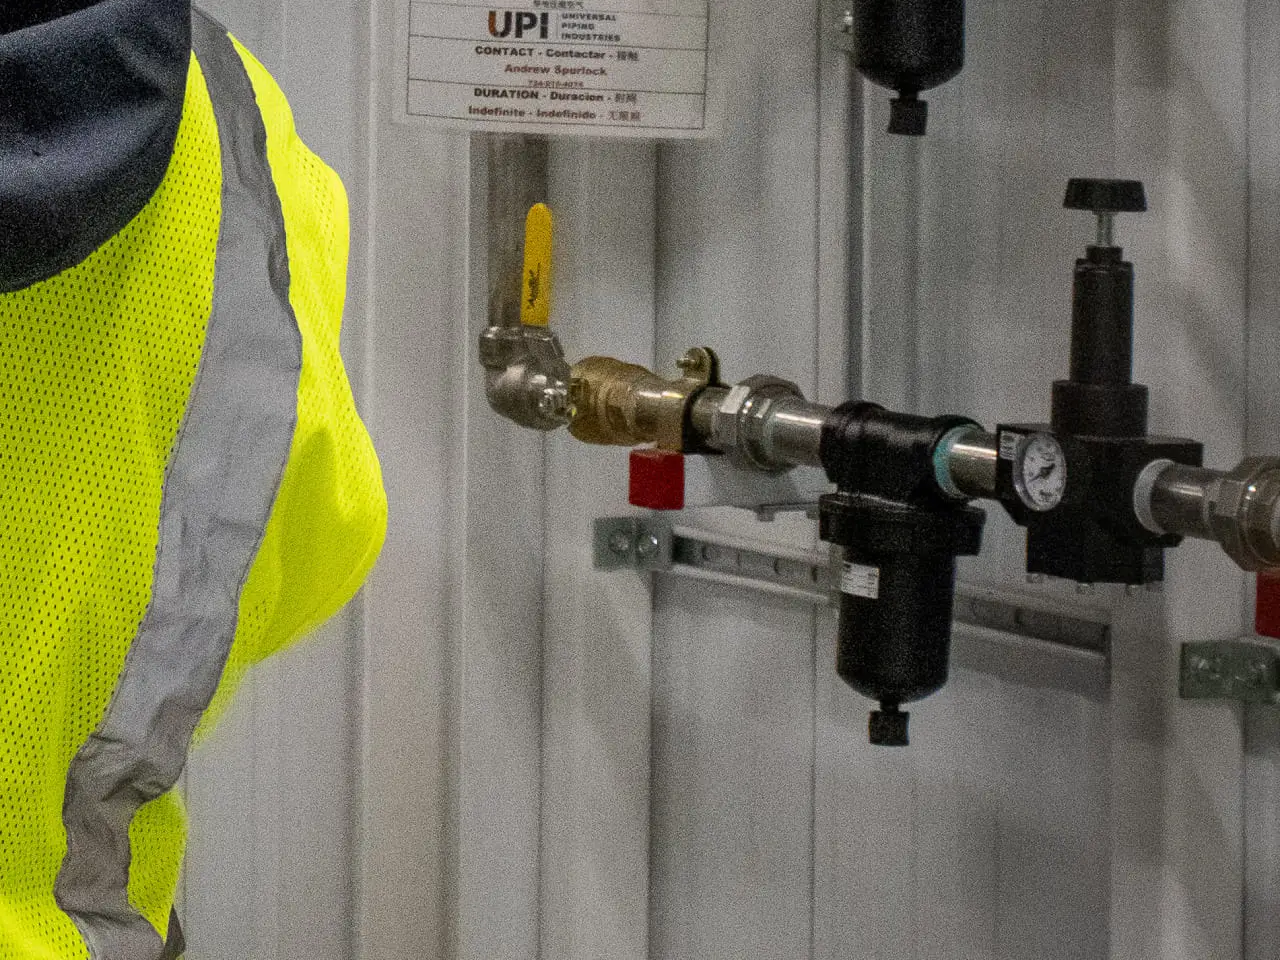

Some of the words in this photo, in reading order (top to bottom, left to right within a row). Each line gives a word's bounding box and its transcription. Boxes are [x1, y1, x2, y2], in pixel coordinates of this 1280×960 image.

[488, 10, 549, 39] UPI
[562, 12, 616, 21] UNIVERSAL
[561, 22, 595, 30] PIPING
[561, 33, 621, 41] INDUSTRIES
[475, 46, 534, 58] CONTACT
[504, 64, 551, 74] Andrew
[554, 65, 608, 76] Spurlock
[474, 88, 539, 100] DURATION
[550, 91, 604, 102] Duracion
[468, 105, 525, 117] Indefinite
[537, 109, 597, 120] Indefinido
